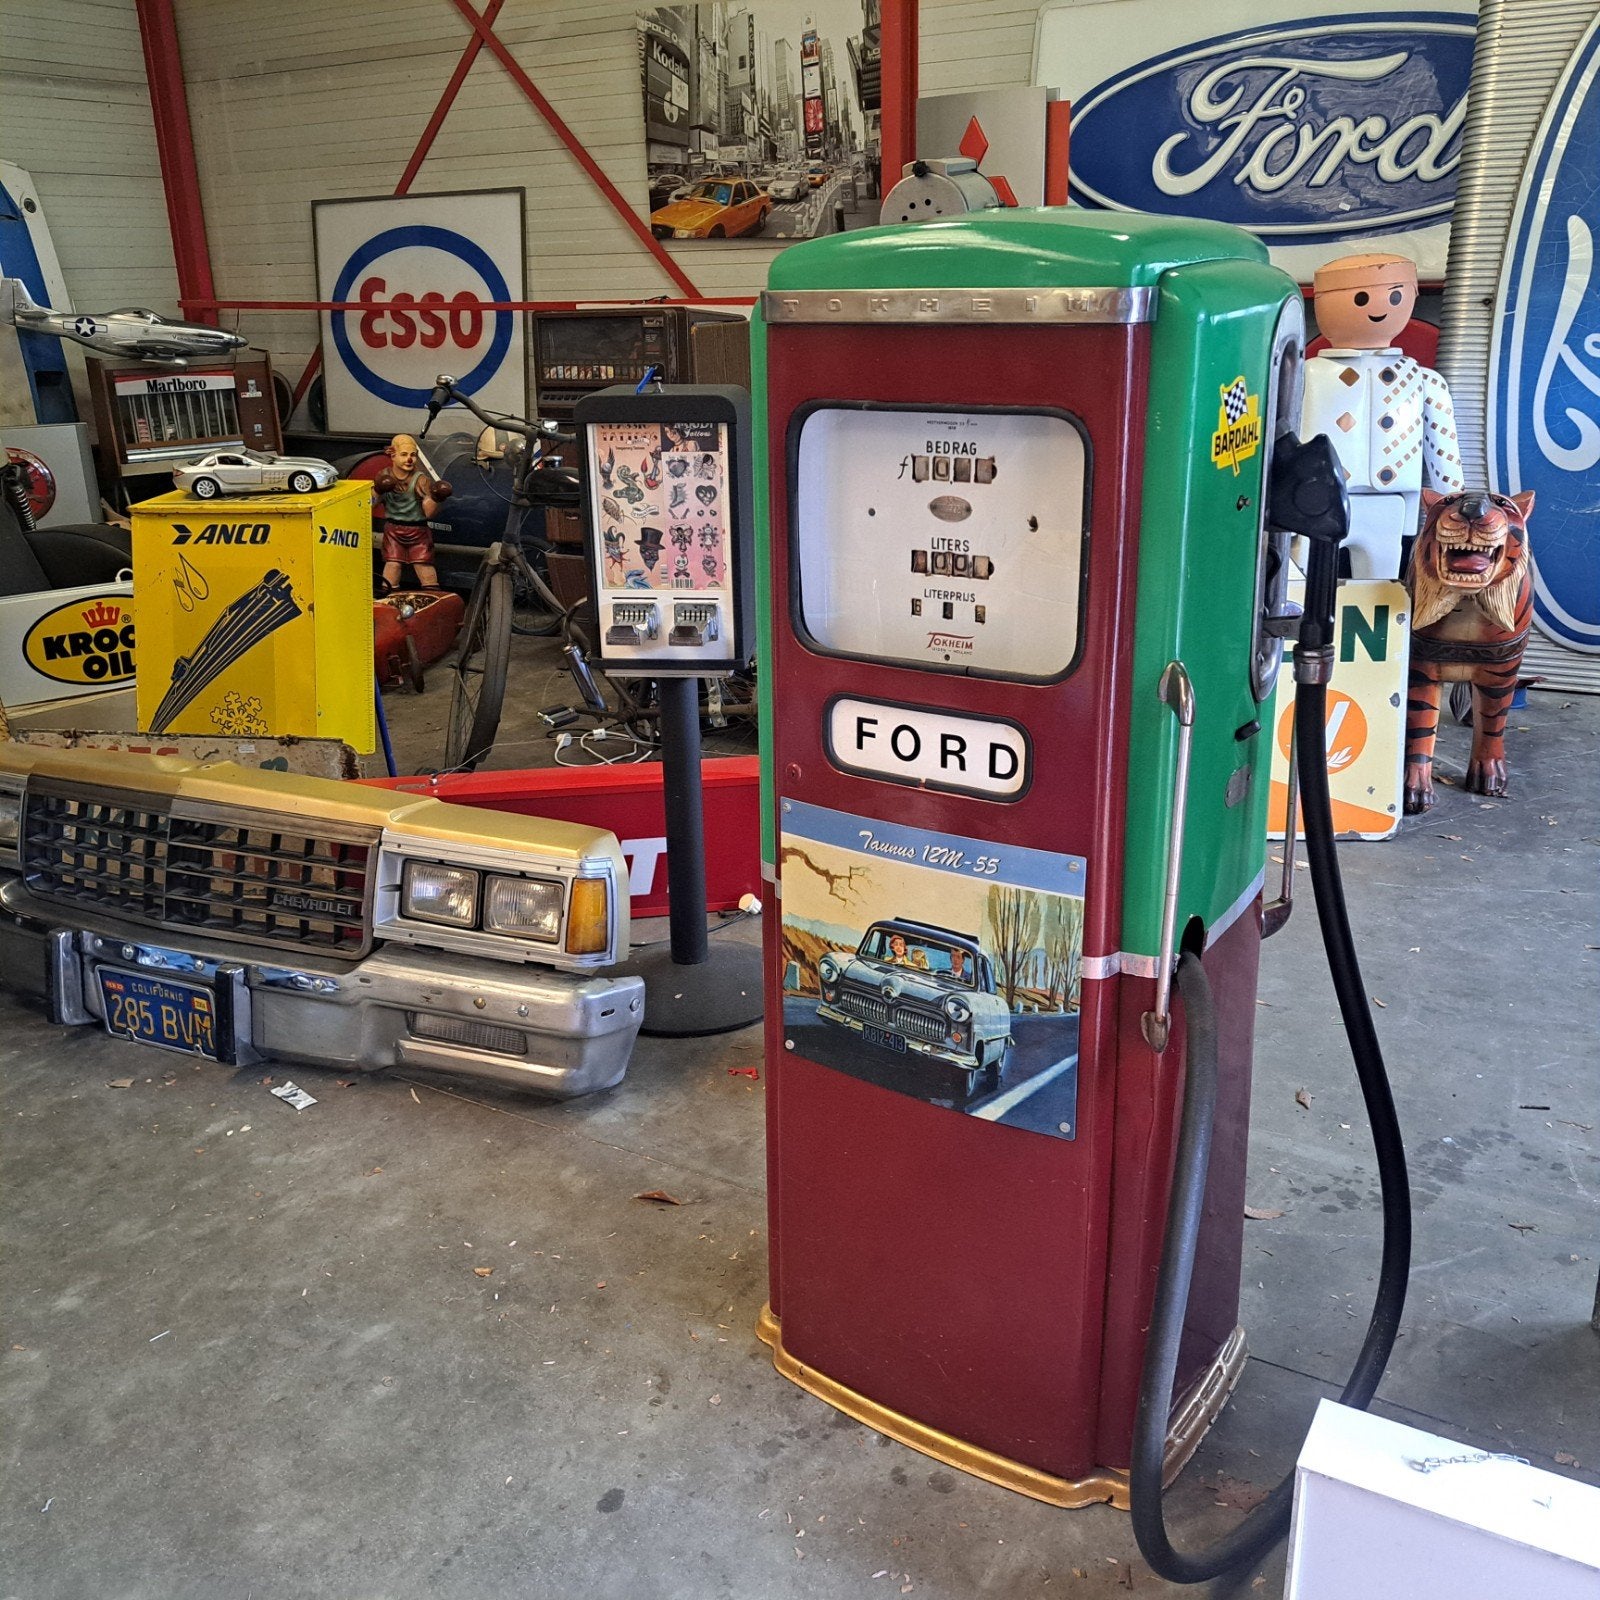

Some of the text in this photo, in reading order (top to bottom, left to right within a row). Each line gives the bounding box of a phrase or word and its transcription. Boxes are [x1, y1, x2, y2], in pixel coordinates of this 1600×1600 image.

[653, 40, 685, 79] Kodak
[1152, 51, 1470, 196] Ford
[783, 295, 1091, 312] TOKHEIM
[146, 378, 207, 393] Marlboro
[926, 440, 977, 456] BEDRAG
[1214, 420, 1259, 457] BARDAHL
[193, 523, 272, 545] ANCO
[328, 528, 359, 548] ANCO
[931, 537, 970, 552] LITERS
[924, 588, 976, 603] LITERPRIJS
[83, 650, 137, 680] OIL
[856, 716, 1019, 780] FORD
[858, 830, 1001, 874] Taunus 12M-55
[273, 893, 354, 916] CHEVROLET
[131, 982, 185, 1003] CALIFORNIA
[111, 993, 214, 1050] 285 BVM
